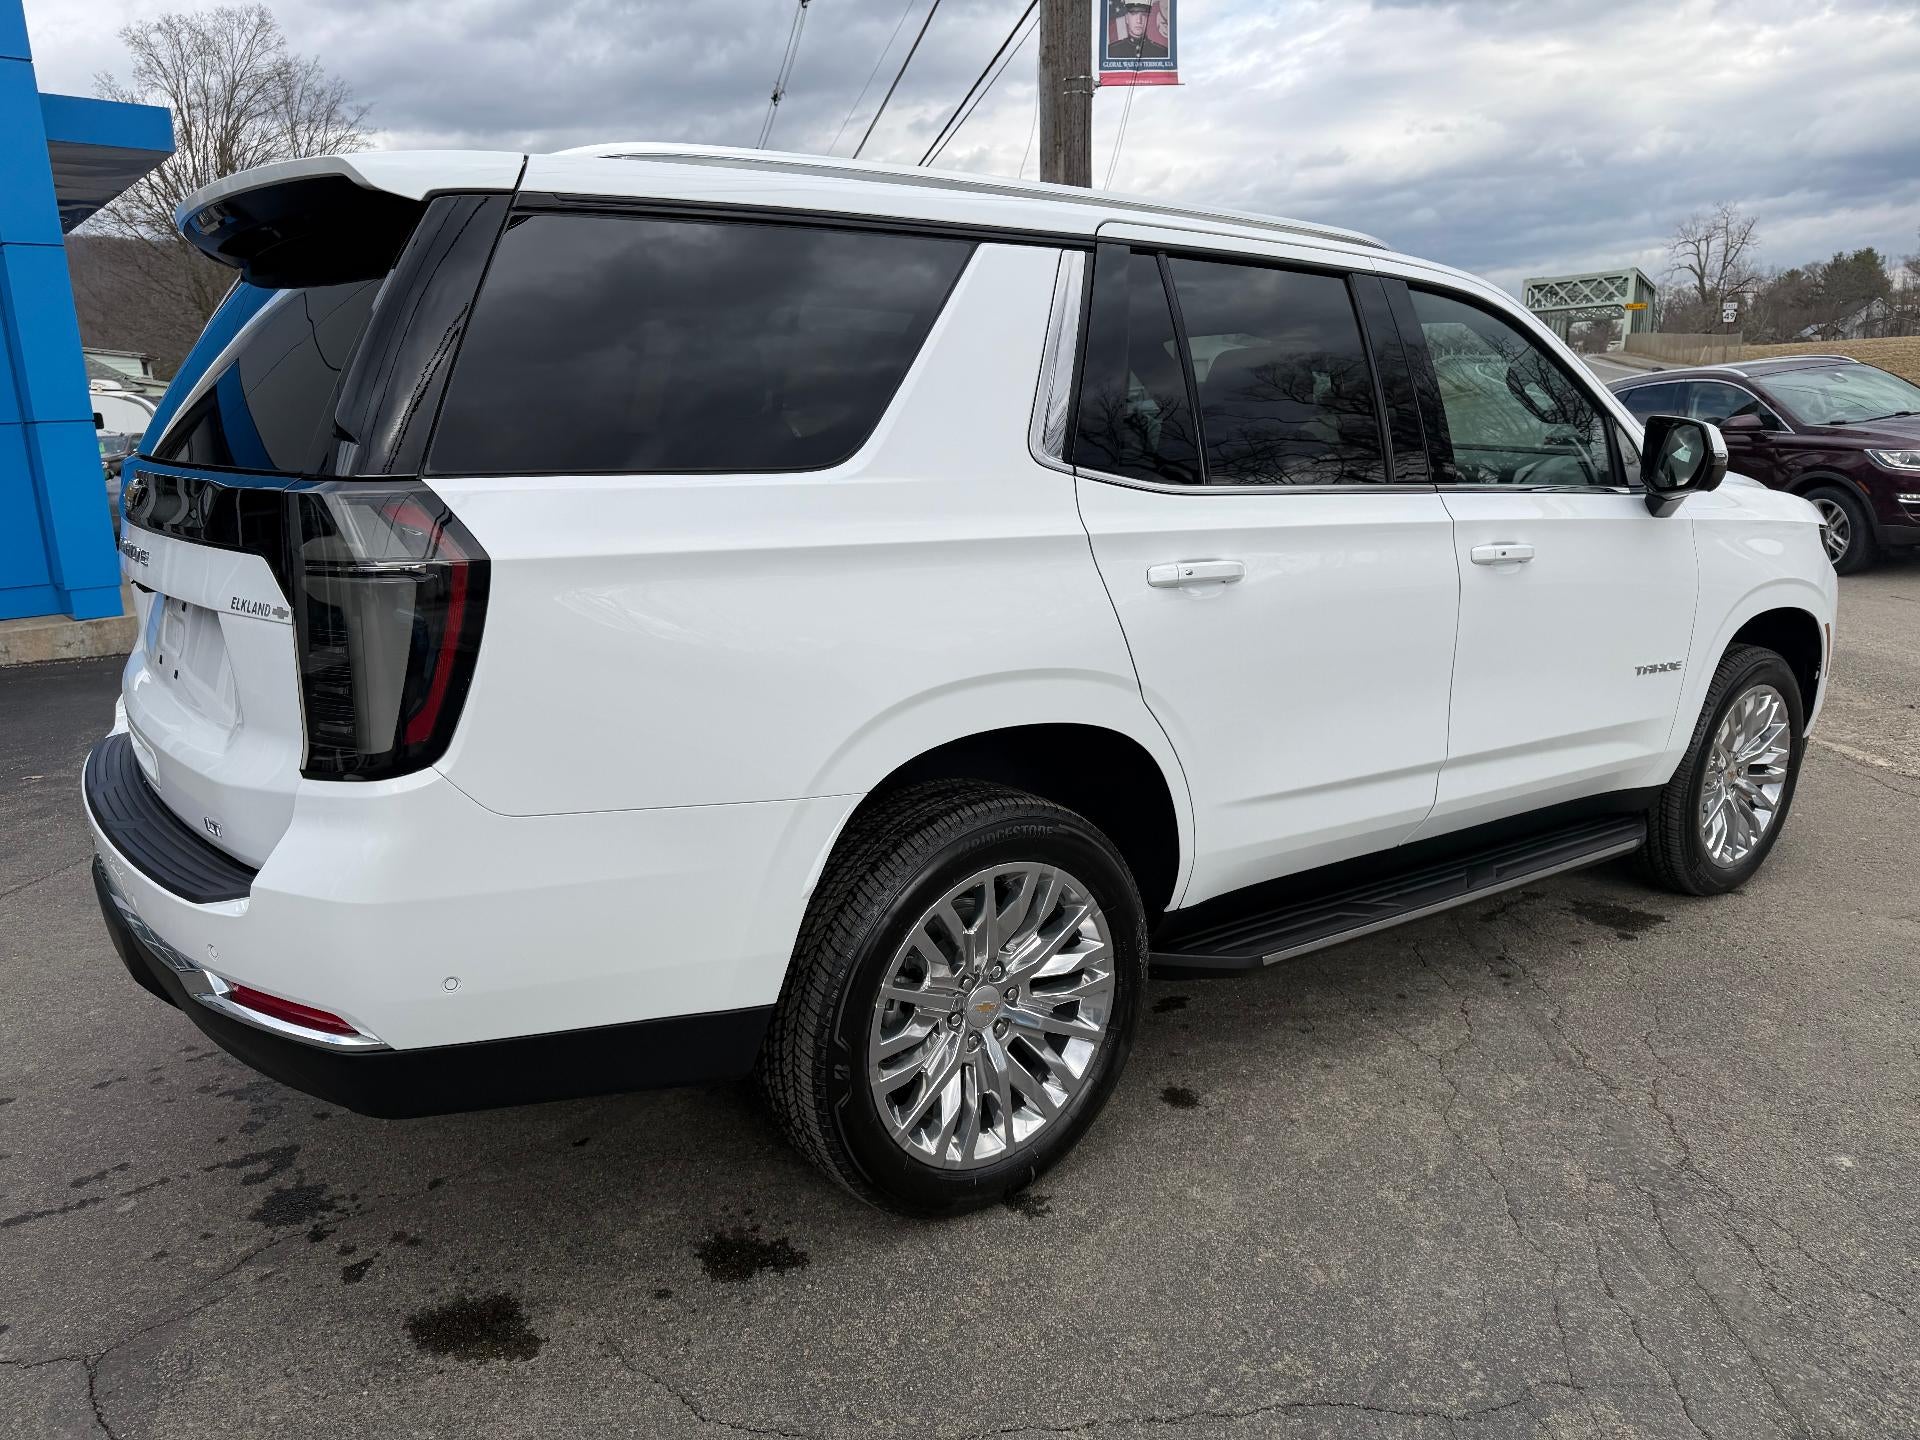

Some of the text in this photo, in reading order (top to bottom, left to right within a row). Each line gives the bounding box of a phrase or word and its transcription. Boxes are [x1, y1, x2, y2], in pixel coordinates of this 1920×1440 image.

[1724, 312, 1735, 320] 49
[230, 596, 271, 617] ELKLAND
[1635, 660, 1682, 676] TAHOE
[203, 816, 222, 837] LT
